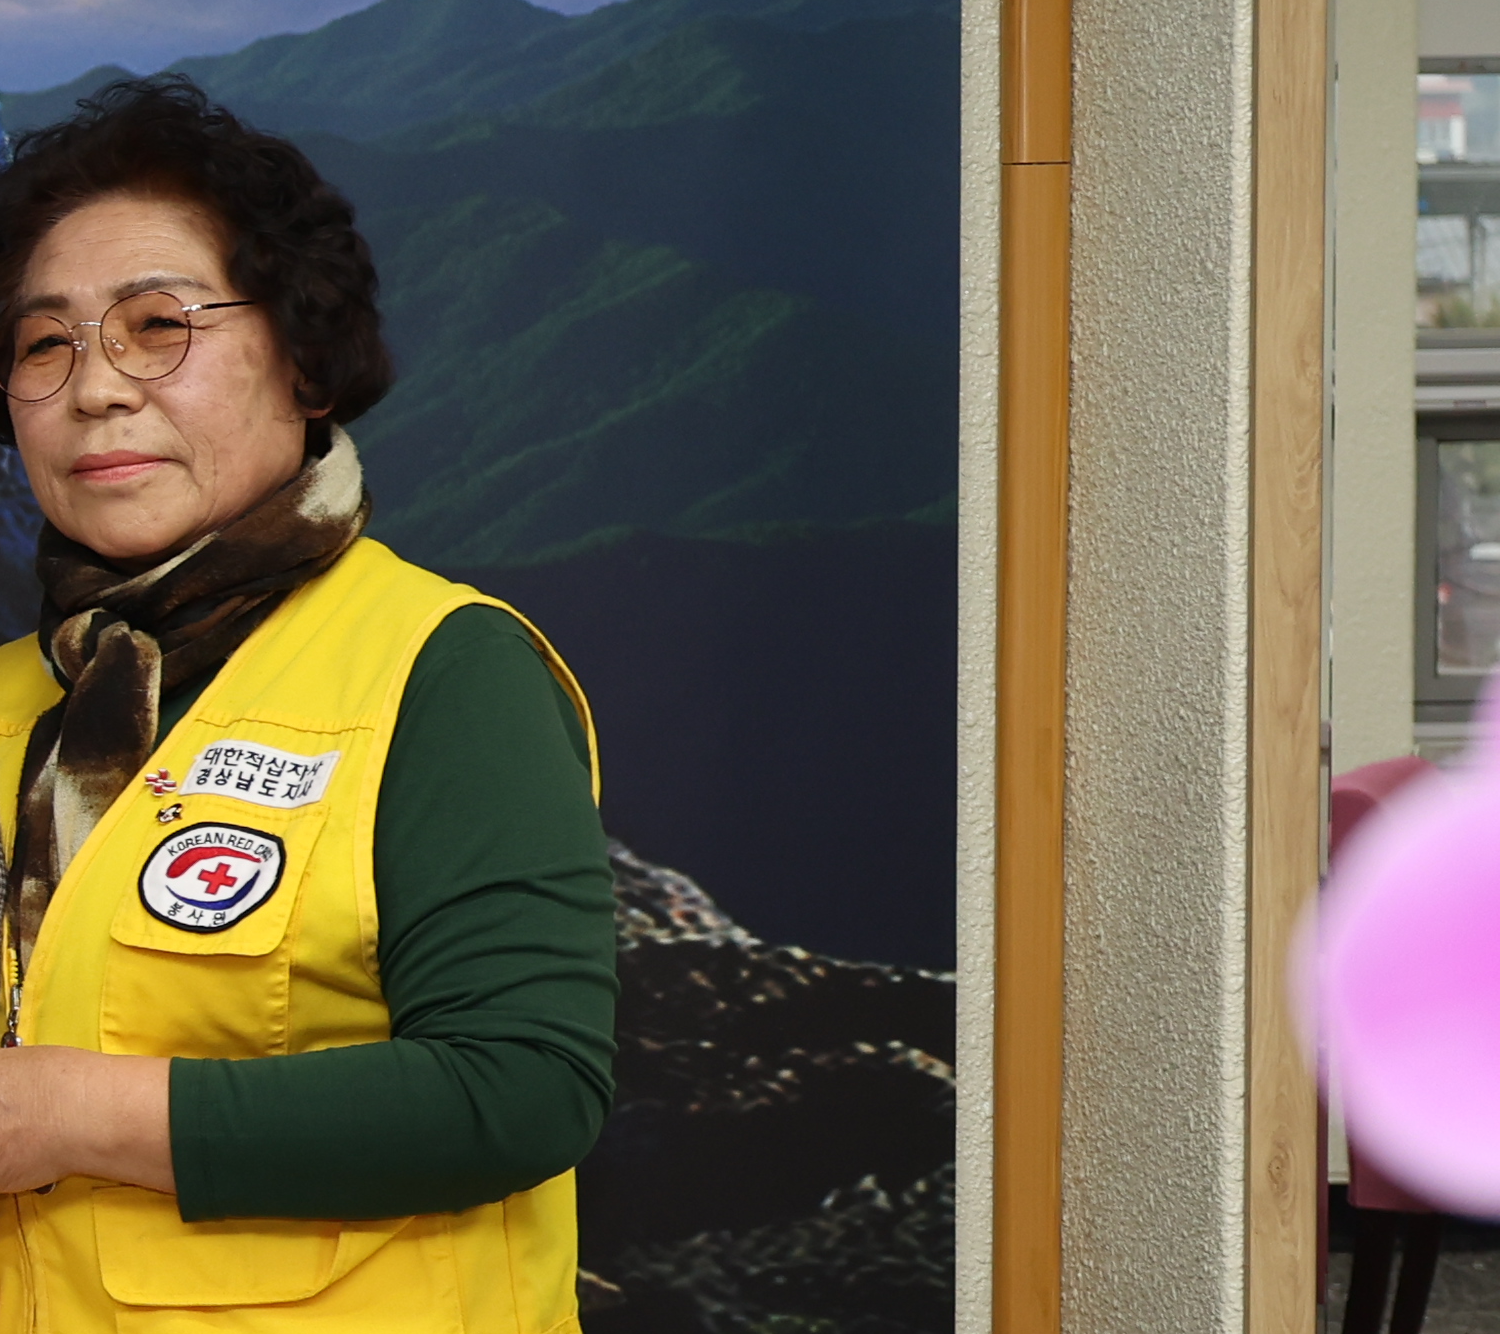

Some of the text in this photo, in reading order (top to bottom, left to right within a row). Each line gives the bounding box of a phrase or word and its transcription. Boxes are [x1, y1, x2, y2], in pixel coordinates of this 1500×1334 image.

[203, 747, 323, 781] 대한적십자사
[196, 767, 314, 800] 경상남도지사
[166, 832, 224, 857] KOREAN
[226, 834, 254, 851] RED
